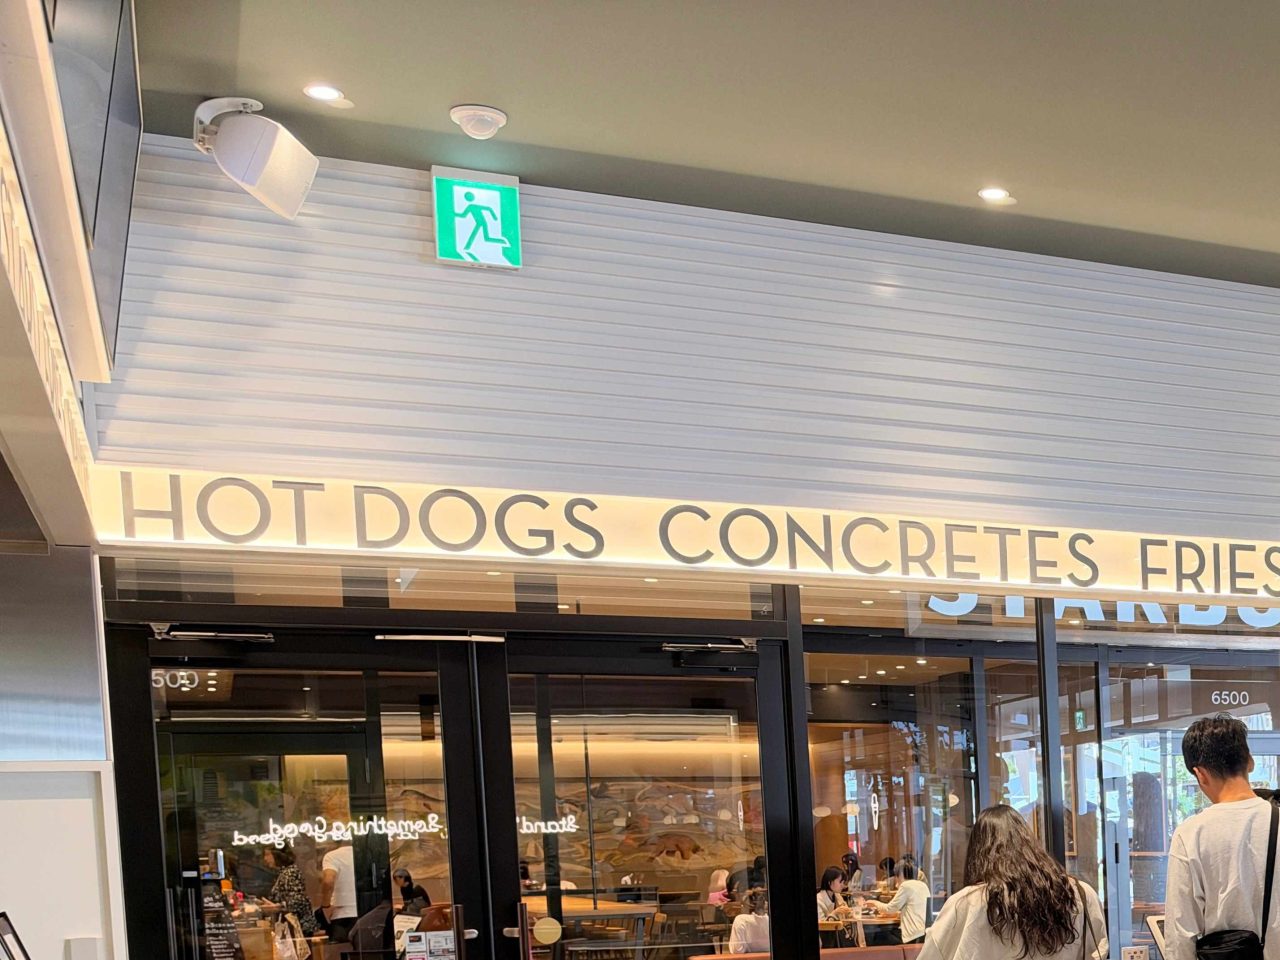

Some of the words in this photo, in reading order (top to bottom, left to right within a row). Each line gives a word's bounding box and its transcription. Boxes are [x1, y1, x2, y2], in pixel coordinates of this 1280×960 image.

[120, 470, 325, 547] HOT
[353, 484, 605, 560] DOGS
[658, 504, 1100, 588] CONCRETES
[1211, 690, 1250, 705] 6500
